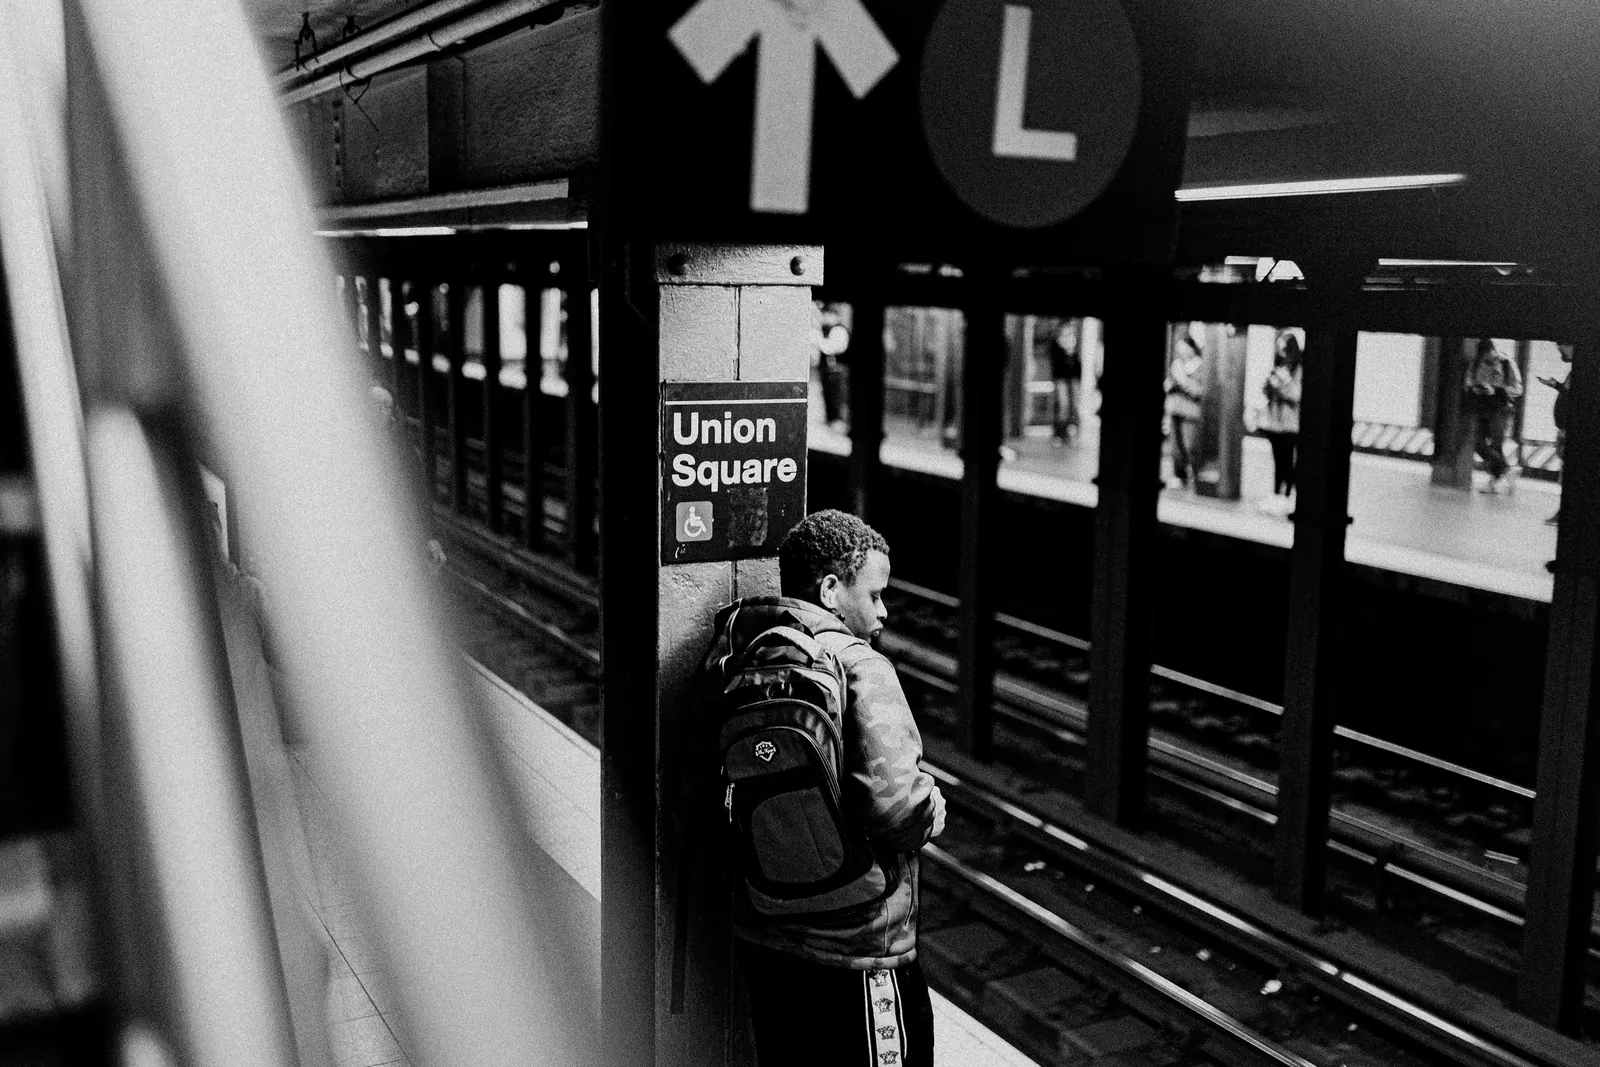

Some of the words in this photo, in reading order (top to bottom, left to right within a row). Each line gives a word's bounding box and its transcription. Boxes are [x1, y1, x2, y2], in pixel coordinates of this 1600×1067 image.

[993, 5, 1077, 161] L
[673, 411, 776, 445] Union
[671, 453, 797, 492] Square
